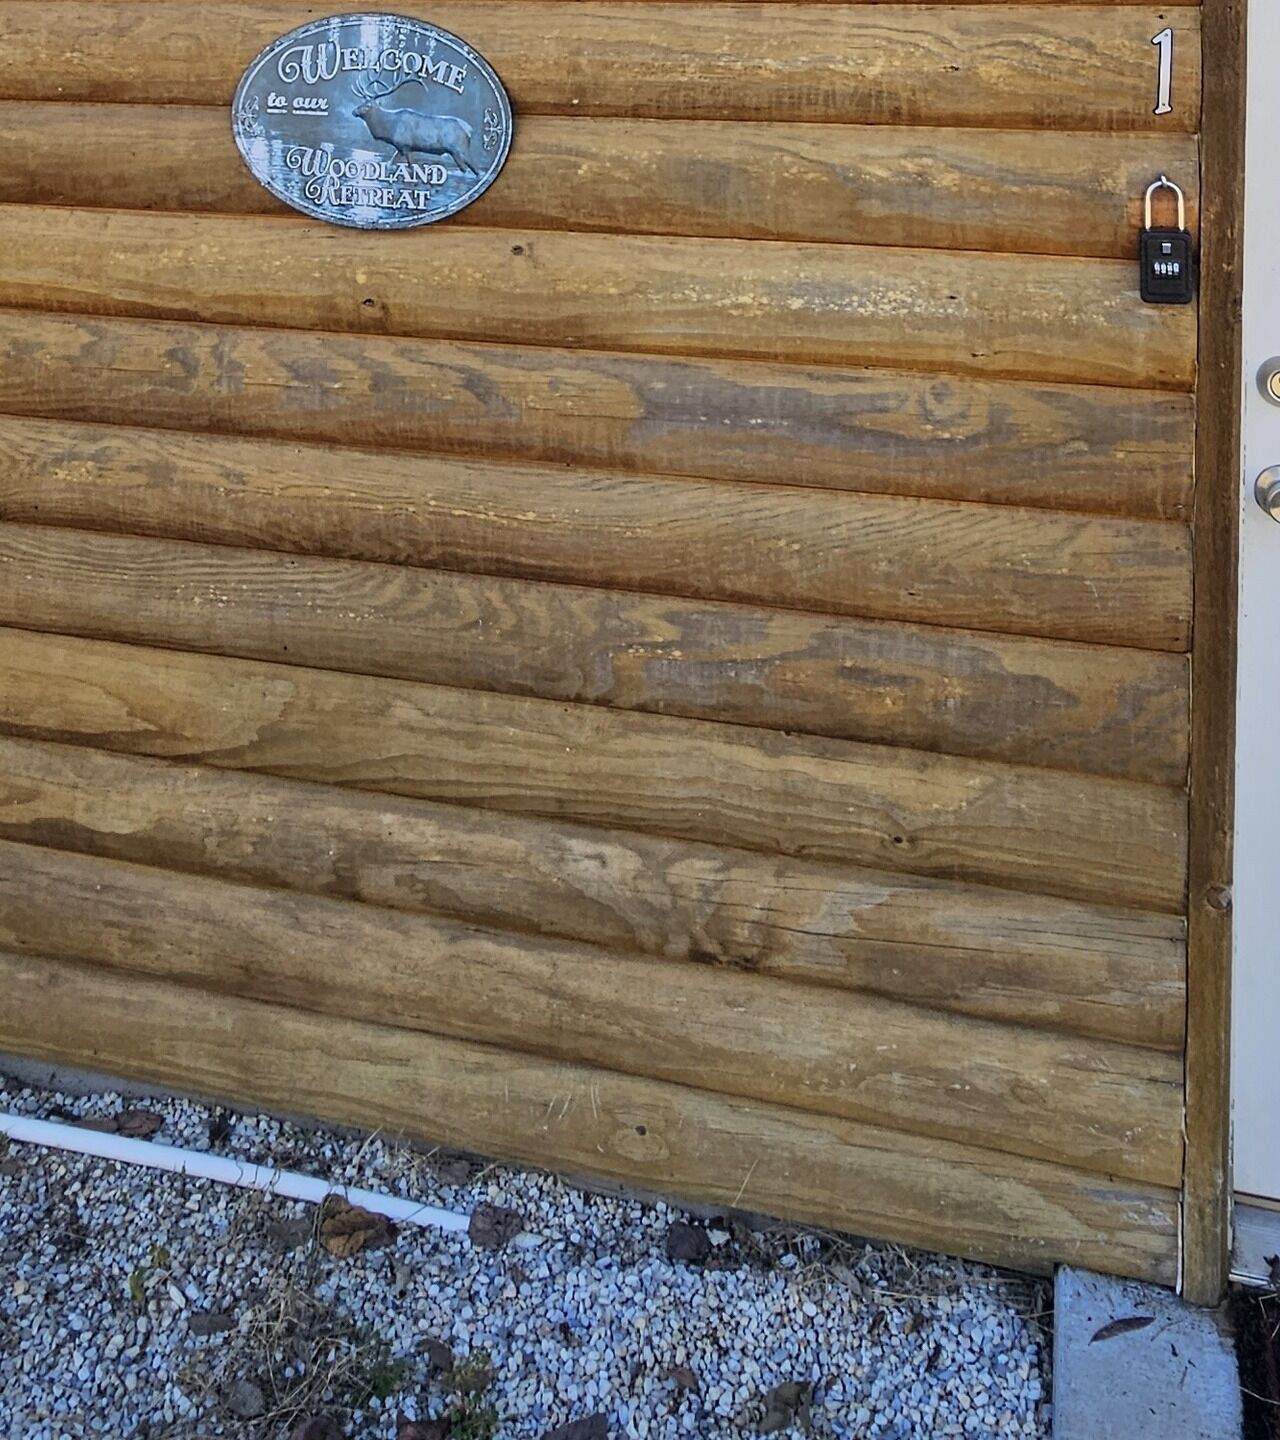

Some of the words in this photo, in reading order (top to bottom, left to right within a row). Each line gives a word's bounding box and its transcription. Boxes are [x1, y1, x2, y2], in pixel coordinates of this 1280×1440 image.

[278, 40, 466, 93] WELCOME
[1151, 28, 1173, 115] 1
[266, 92, 288, 109] to
[292, 95, 329, 110] our
[287, 144, 447, 185] WOODLAND
[304, 174, 431, 210] RETREAT
